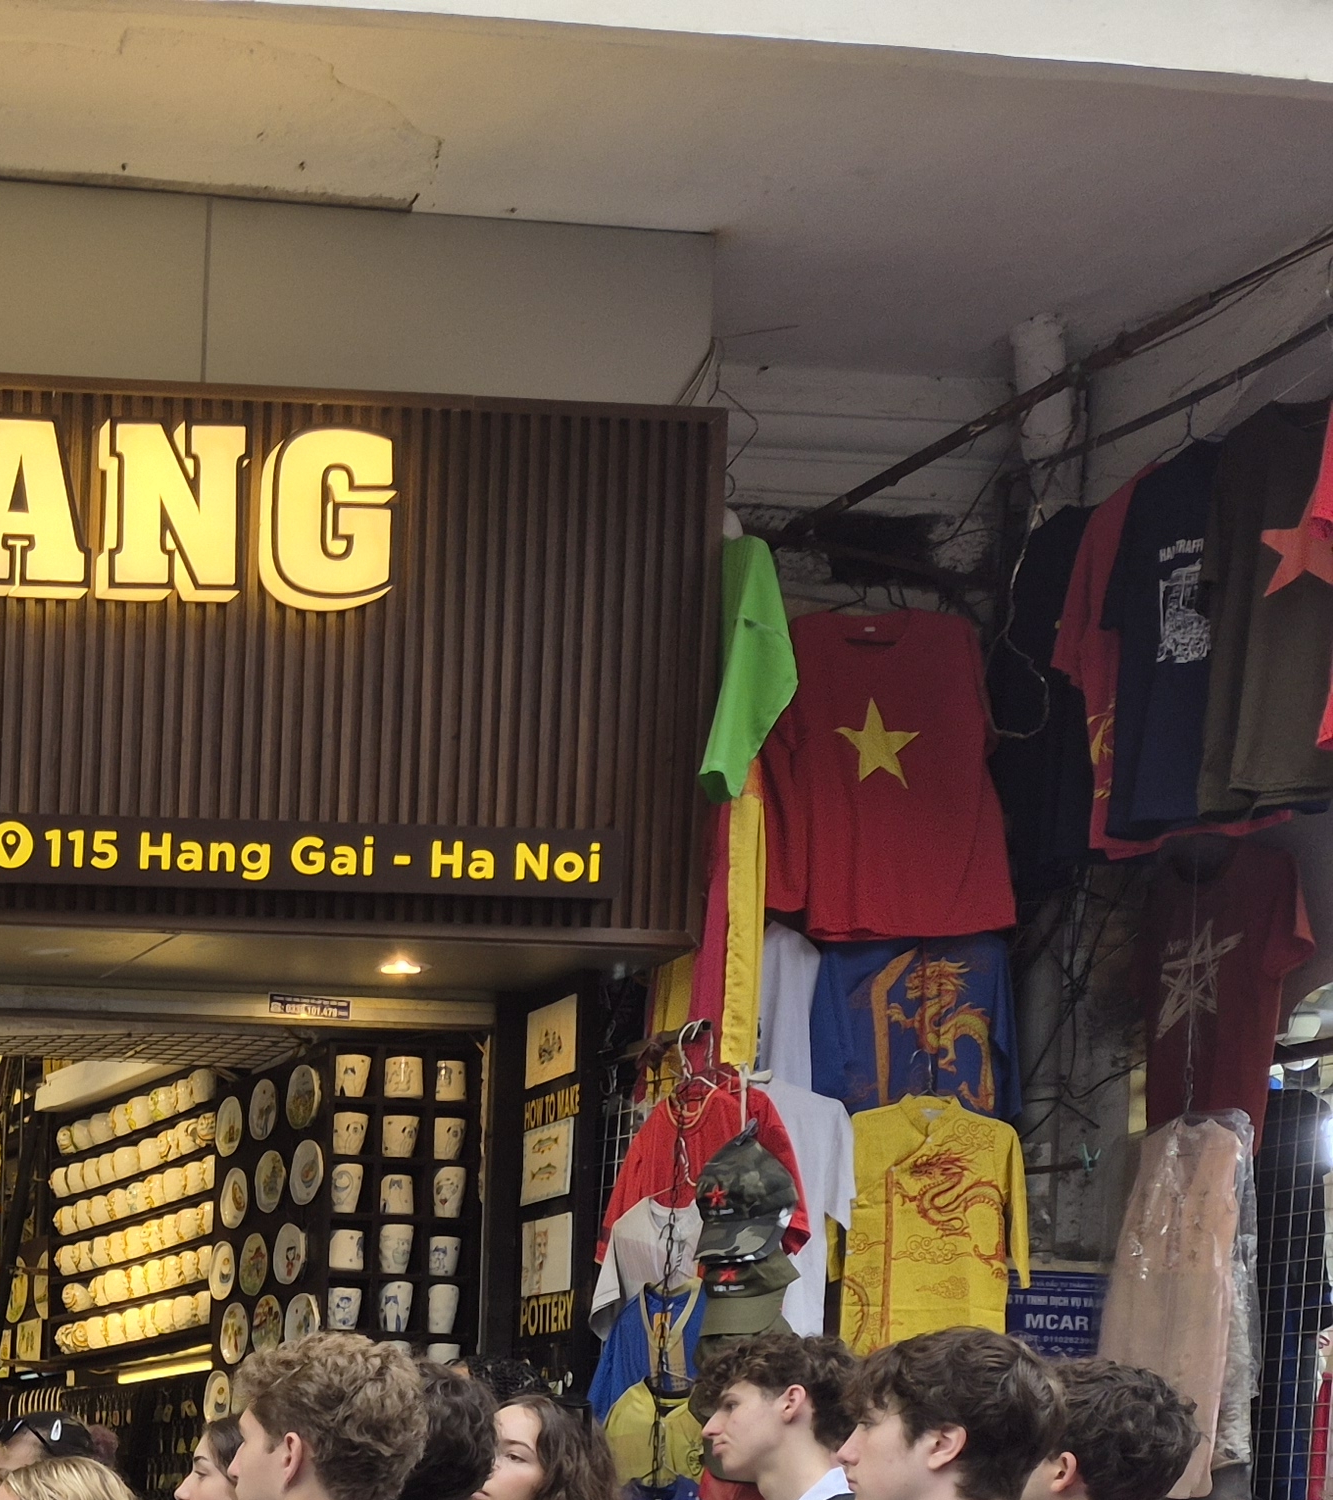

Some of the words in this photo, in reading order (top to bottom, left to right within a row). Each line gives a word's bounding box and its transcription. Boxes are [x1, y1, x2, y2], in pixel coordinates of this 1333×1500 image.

[44, 829, 118, 869] 115
[139, 832, 271, 881] Hang
[290, 836, 374, 876] Gai
[393, 855, 412, 865] -
[430, 841, 495, 880] Ha
[515, 842, 601, 883] Noi
[524, 1098, 545, 1130] HOW
[545, 1094, 556, 1124] TO
[557, 1083, 580, 1120] MAKE
[520, 1290, 575, 1337] POTTERY
[1025, 1313, 1089, 1331] MCAR
